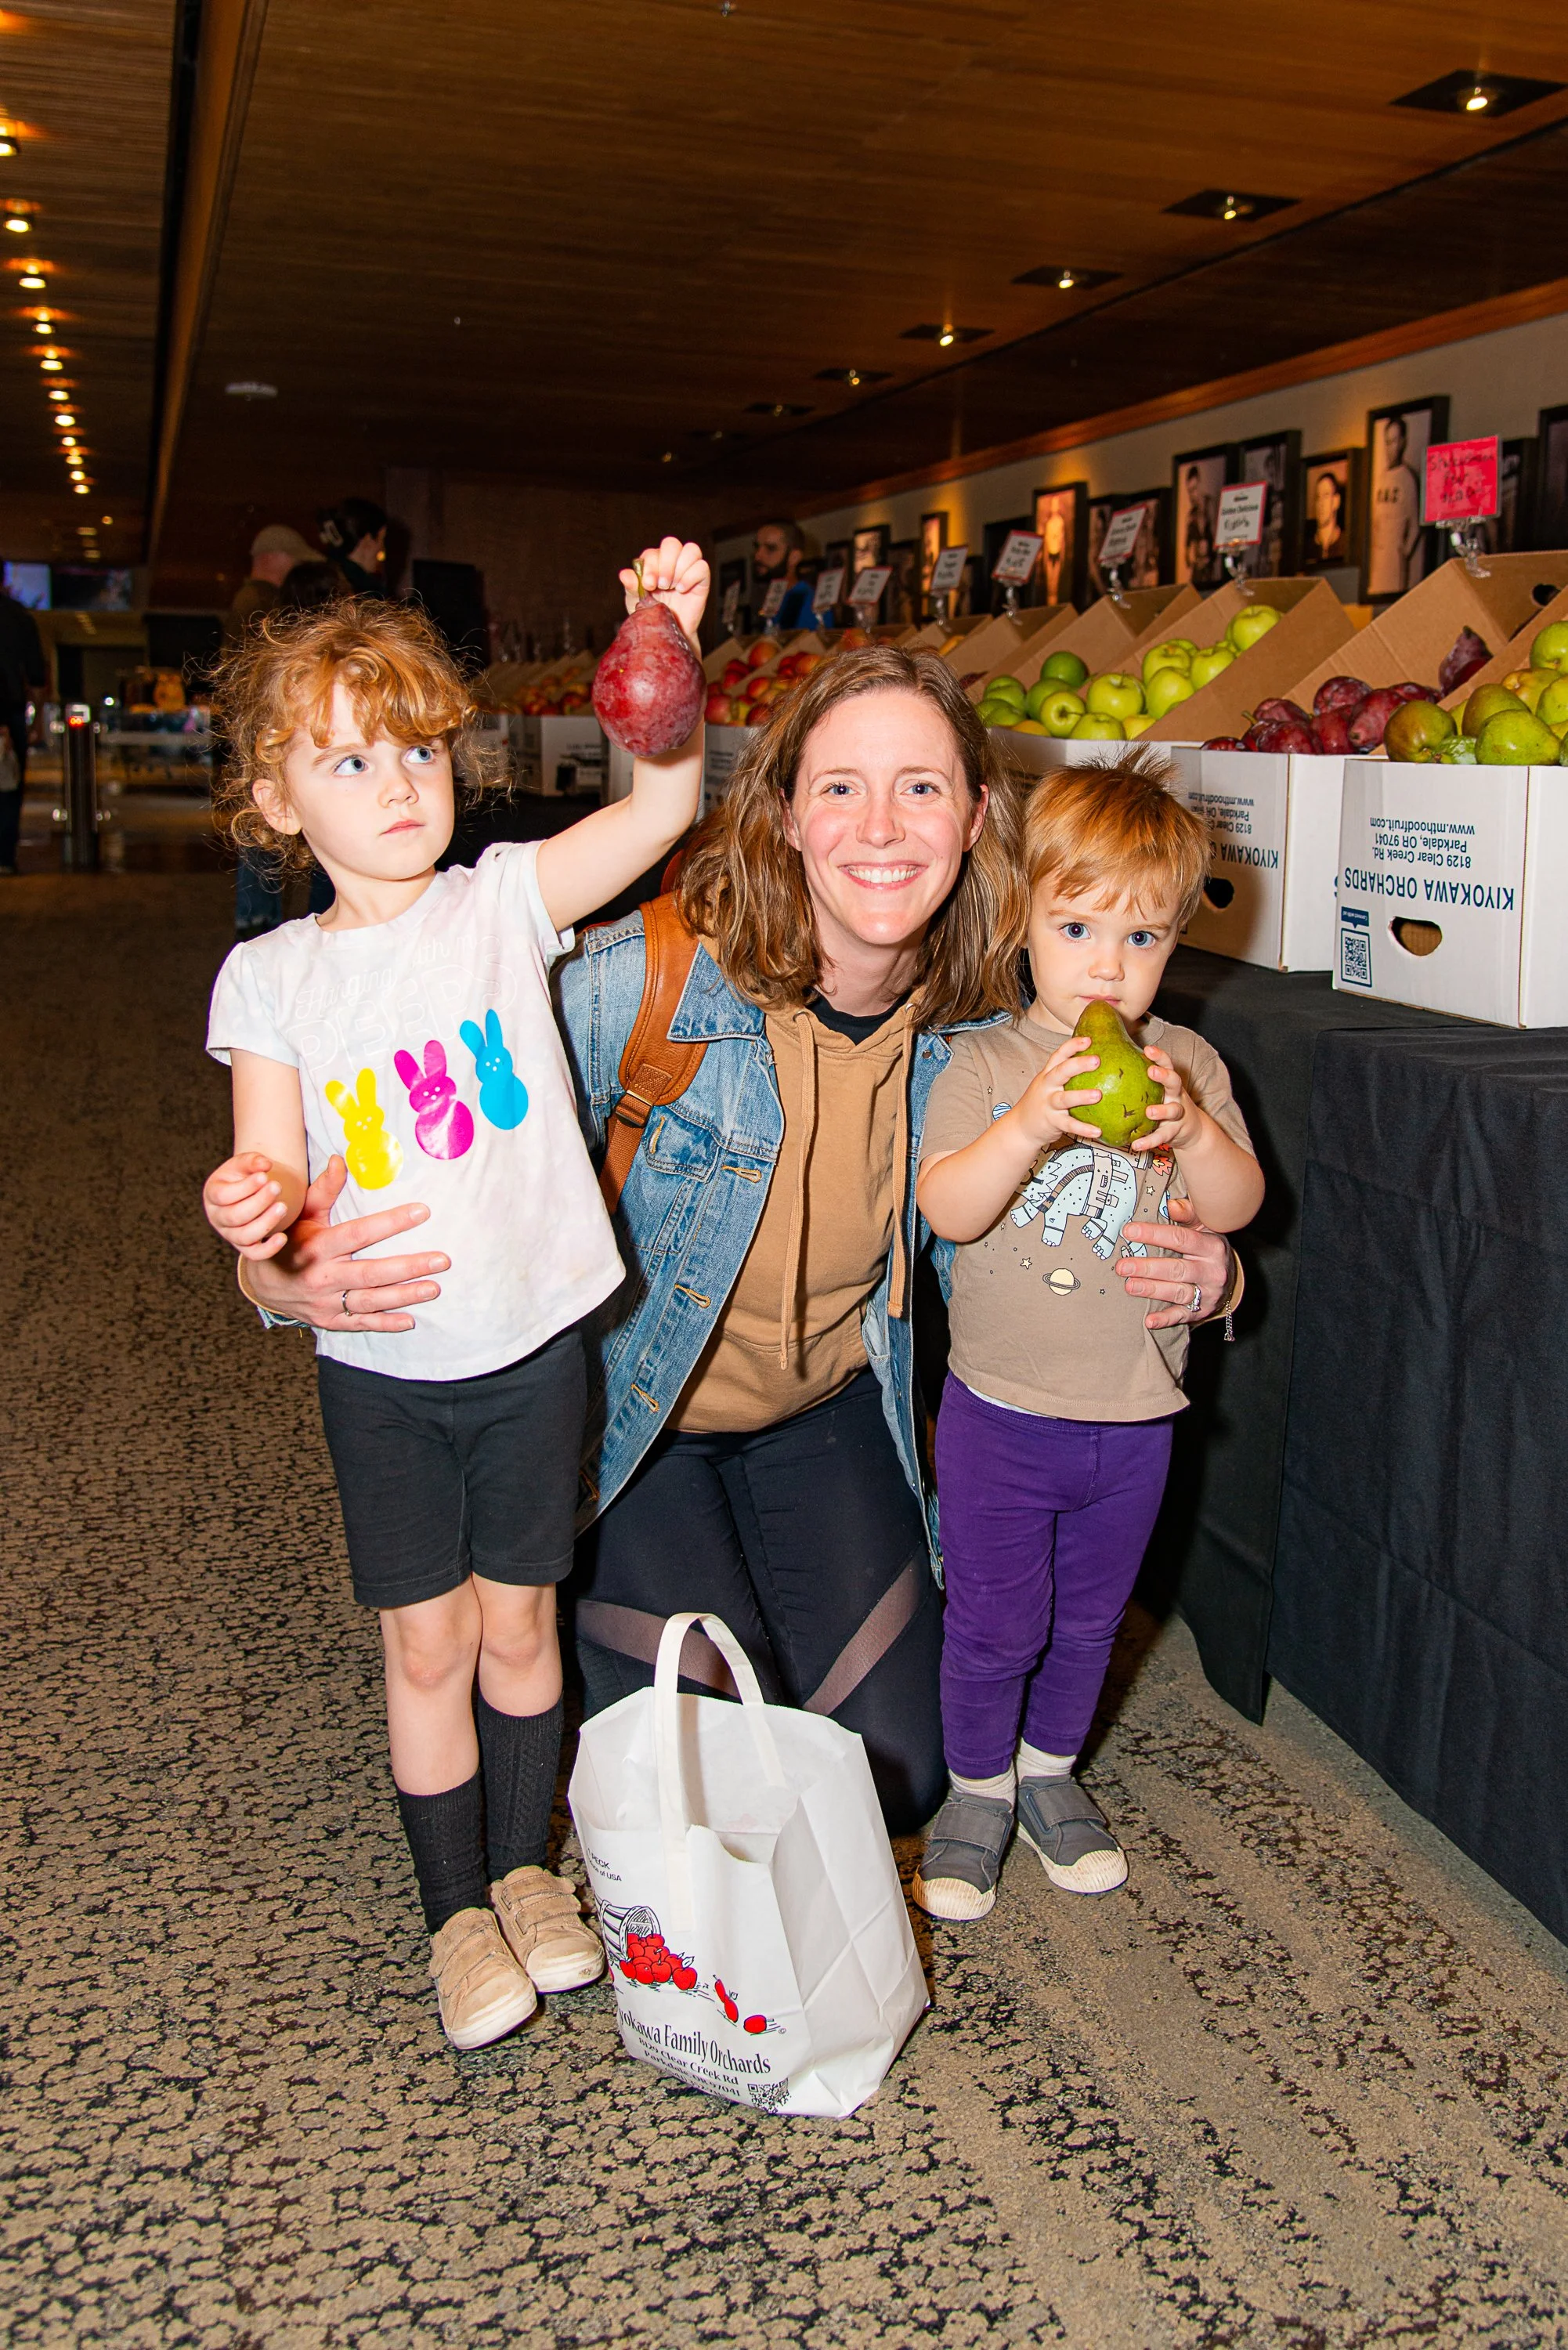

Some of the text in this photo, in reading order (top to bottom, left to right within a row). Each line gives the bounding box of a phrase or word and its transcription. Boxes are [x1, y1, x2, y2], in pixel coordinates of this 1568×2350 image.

[1216, 820, 1234, 833] Clear
[1218, 807, 1249, 822] Parkdale,
[1369, 816, 1475, 835] www.mthoodfruit.com
[1235, 822, 1252, 835] 8129
[1375, 833, 1467, 852] Parkdale, OR 97041
[1220, 842, 1279, 869] KIYOKAWA
[1372, 847, 1472, 869] 8129 Clear Creek Rd.
[1344, 867, 1418, 899] ORCHARDS
[1423, 878, 1514, 911] KIYOKAWA
[294, 967, 397, 1020] Hanging
[412, 938, 450, 968] ith
[285, 935, 518, 1077] PEEPS
[606, 1871, 623, 1882] USA
[619, 2008, 771, 2074] yokawa Family Orchards
[660, 2050, 688, 2068] Clear
[690, 2062, 721, 2081] Creek
[722, 2074, 739, 2084] Rd
